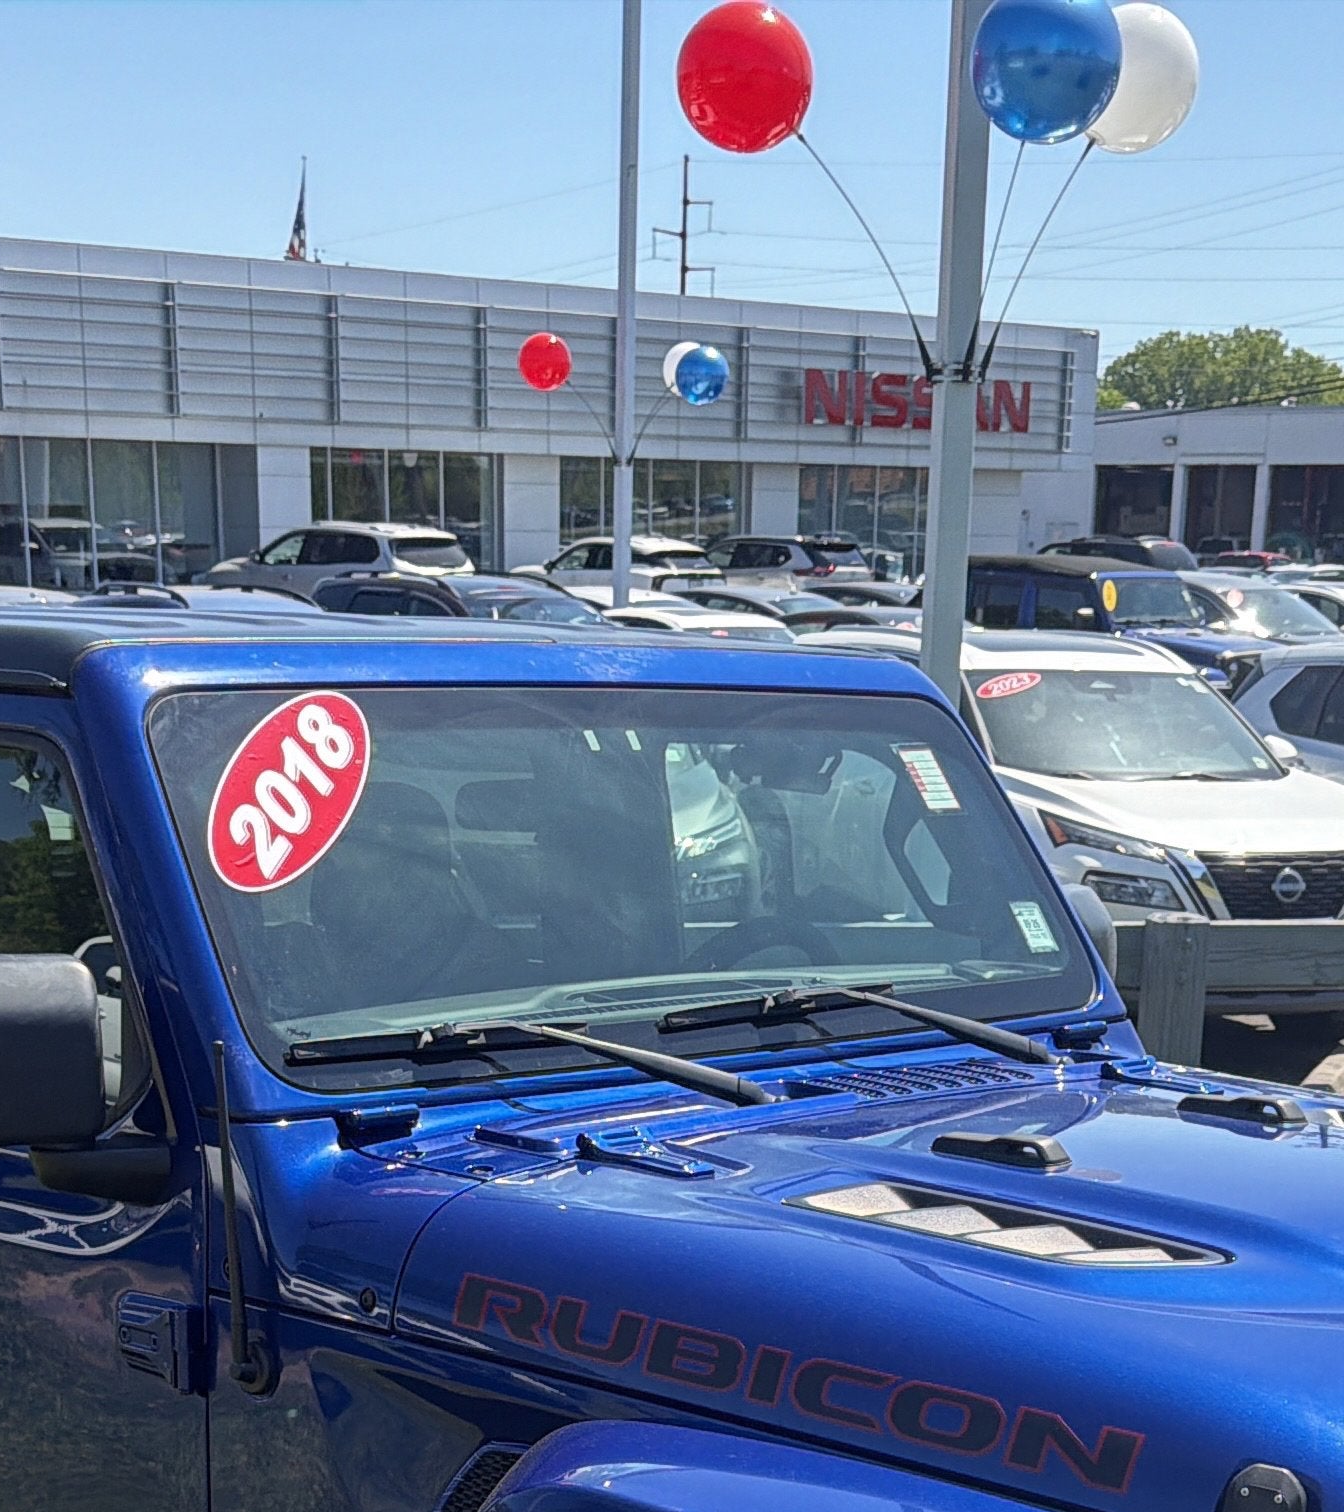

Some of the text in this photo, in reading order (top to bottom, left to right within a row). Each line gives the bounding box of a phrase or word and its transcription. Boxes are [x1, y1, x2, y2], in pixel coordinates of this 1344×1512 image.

[989, 672, 1032, 696] 2023
[229, 704, 355, 880] 2018
[454, 1273, 1147, 1495] RUBICON
